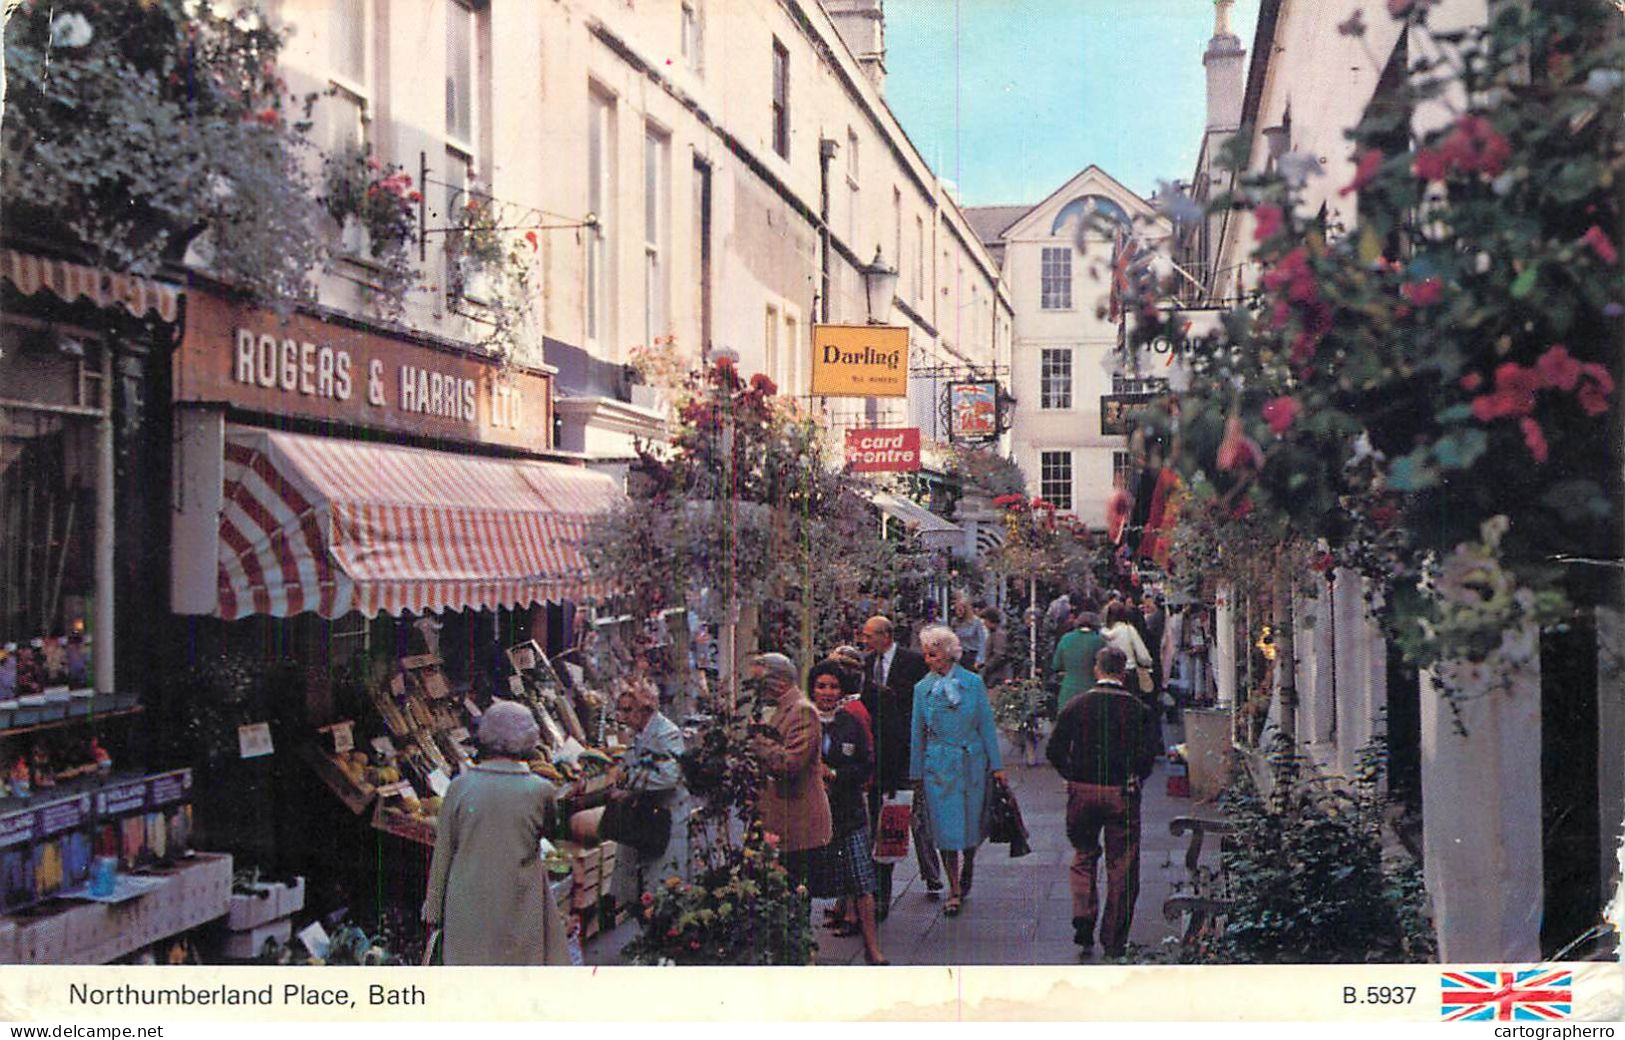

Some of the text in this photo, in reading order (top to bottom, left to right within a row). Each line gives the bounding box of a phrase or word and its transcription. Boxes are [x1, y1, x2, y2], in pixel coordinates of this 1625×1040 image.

[823, 344, 900, 369] Darling
[235, 328, 523, 428] ROGERS & HARRIS LTD
[860, 433, 905, 449] card
[71, 984, 424, 1008] Northumberland Place, Bath
[1344, 987, 1416, 1004] B.5937
